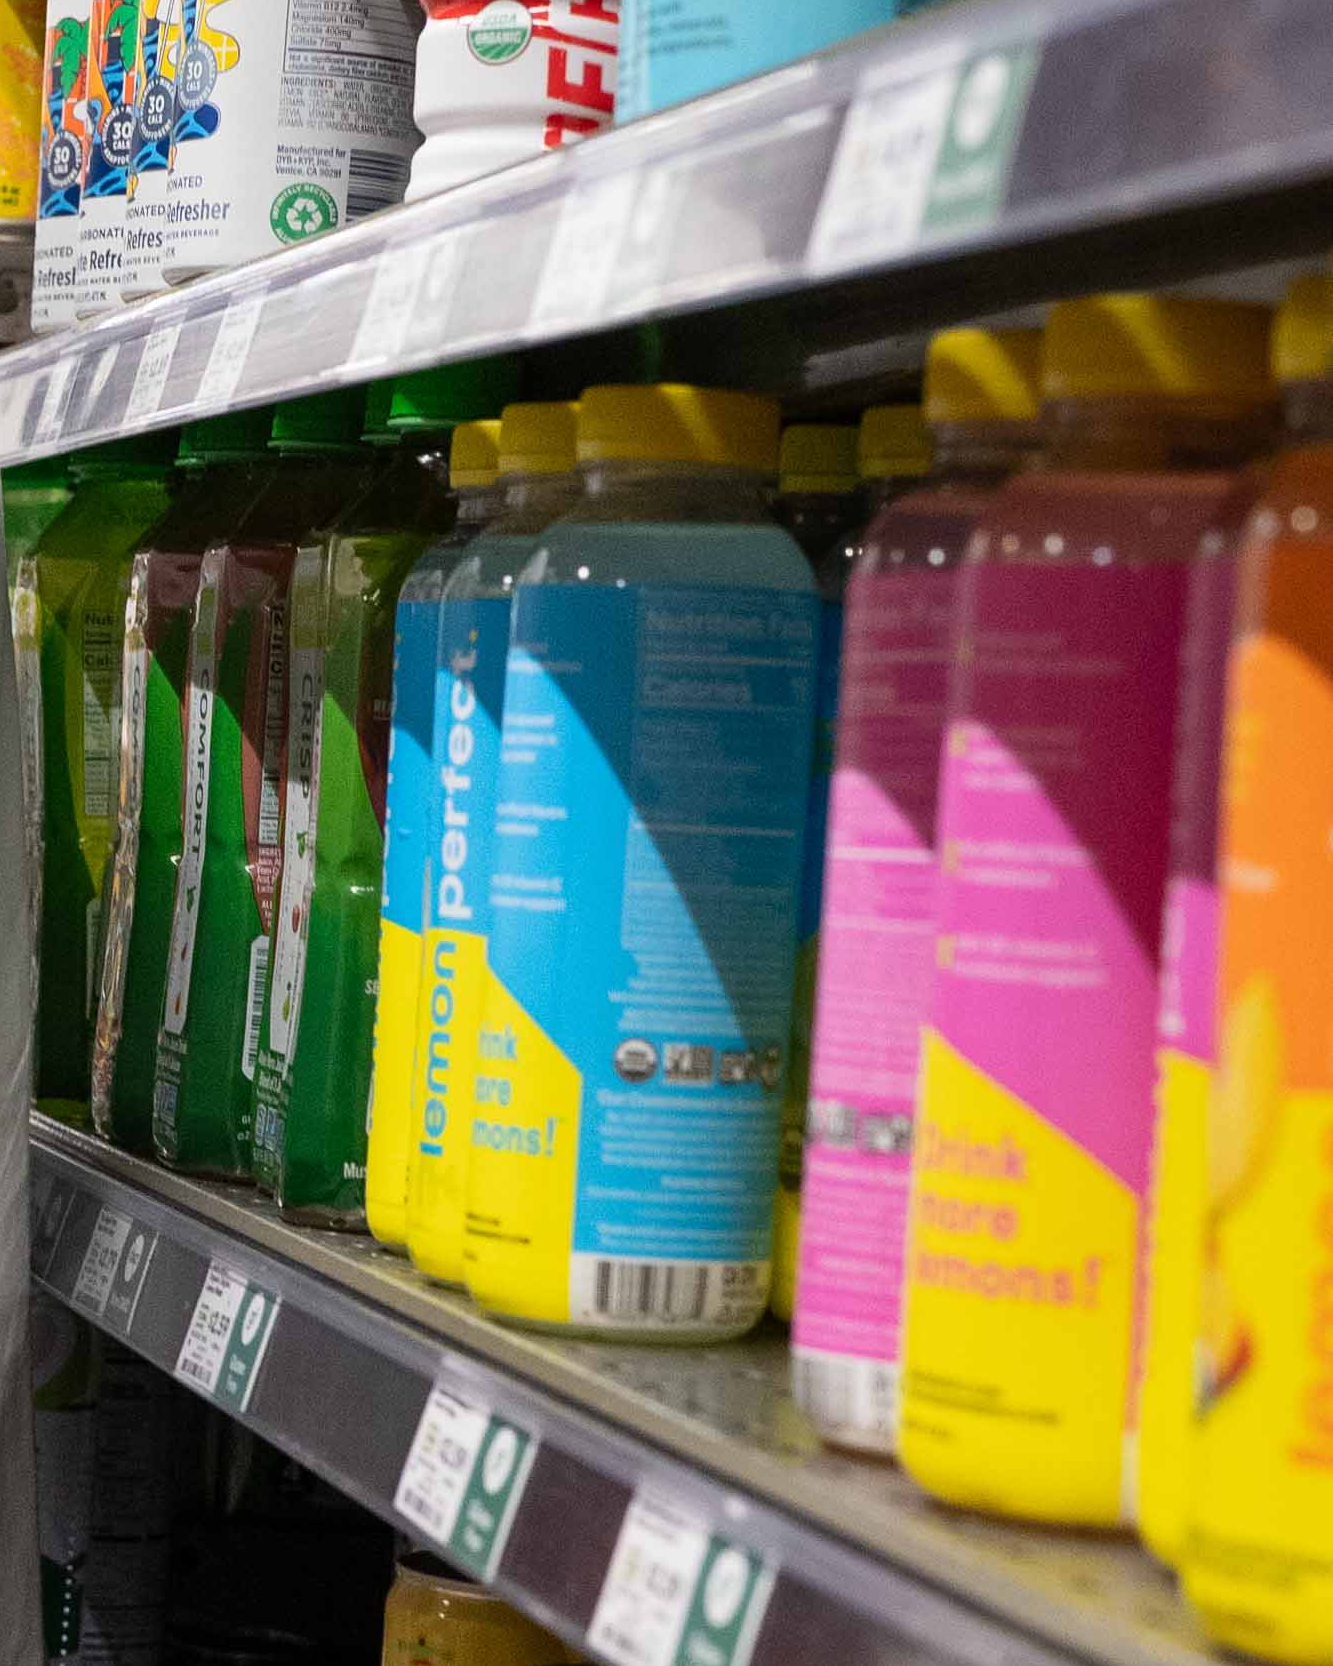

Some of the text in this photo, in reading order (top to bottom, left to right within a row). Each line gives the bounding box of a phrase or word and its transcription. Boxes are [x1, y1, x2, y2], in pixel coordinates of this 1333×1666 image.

[293, 0, 322, 10] Vitamin
[186, 61, 203, 79] 30
[147, 96, 165, 114] 30
[113, 123, 133, 141] 30
[53, 146, 70, 163] 30
[277, 144, 346, 158] Manufactured for
[307, 167, 317, 176] CA
[299, 673, 315, 800] CRISP
[193, 668, 210, 862] COMFORT
[419, 940, 457, 1157] lemon
